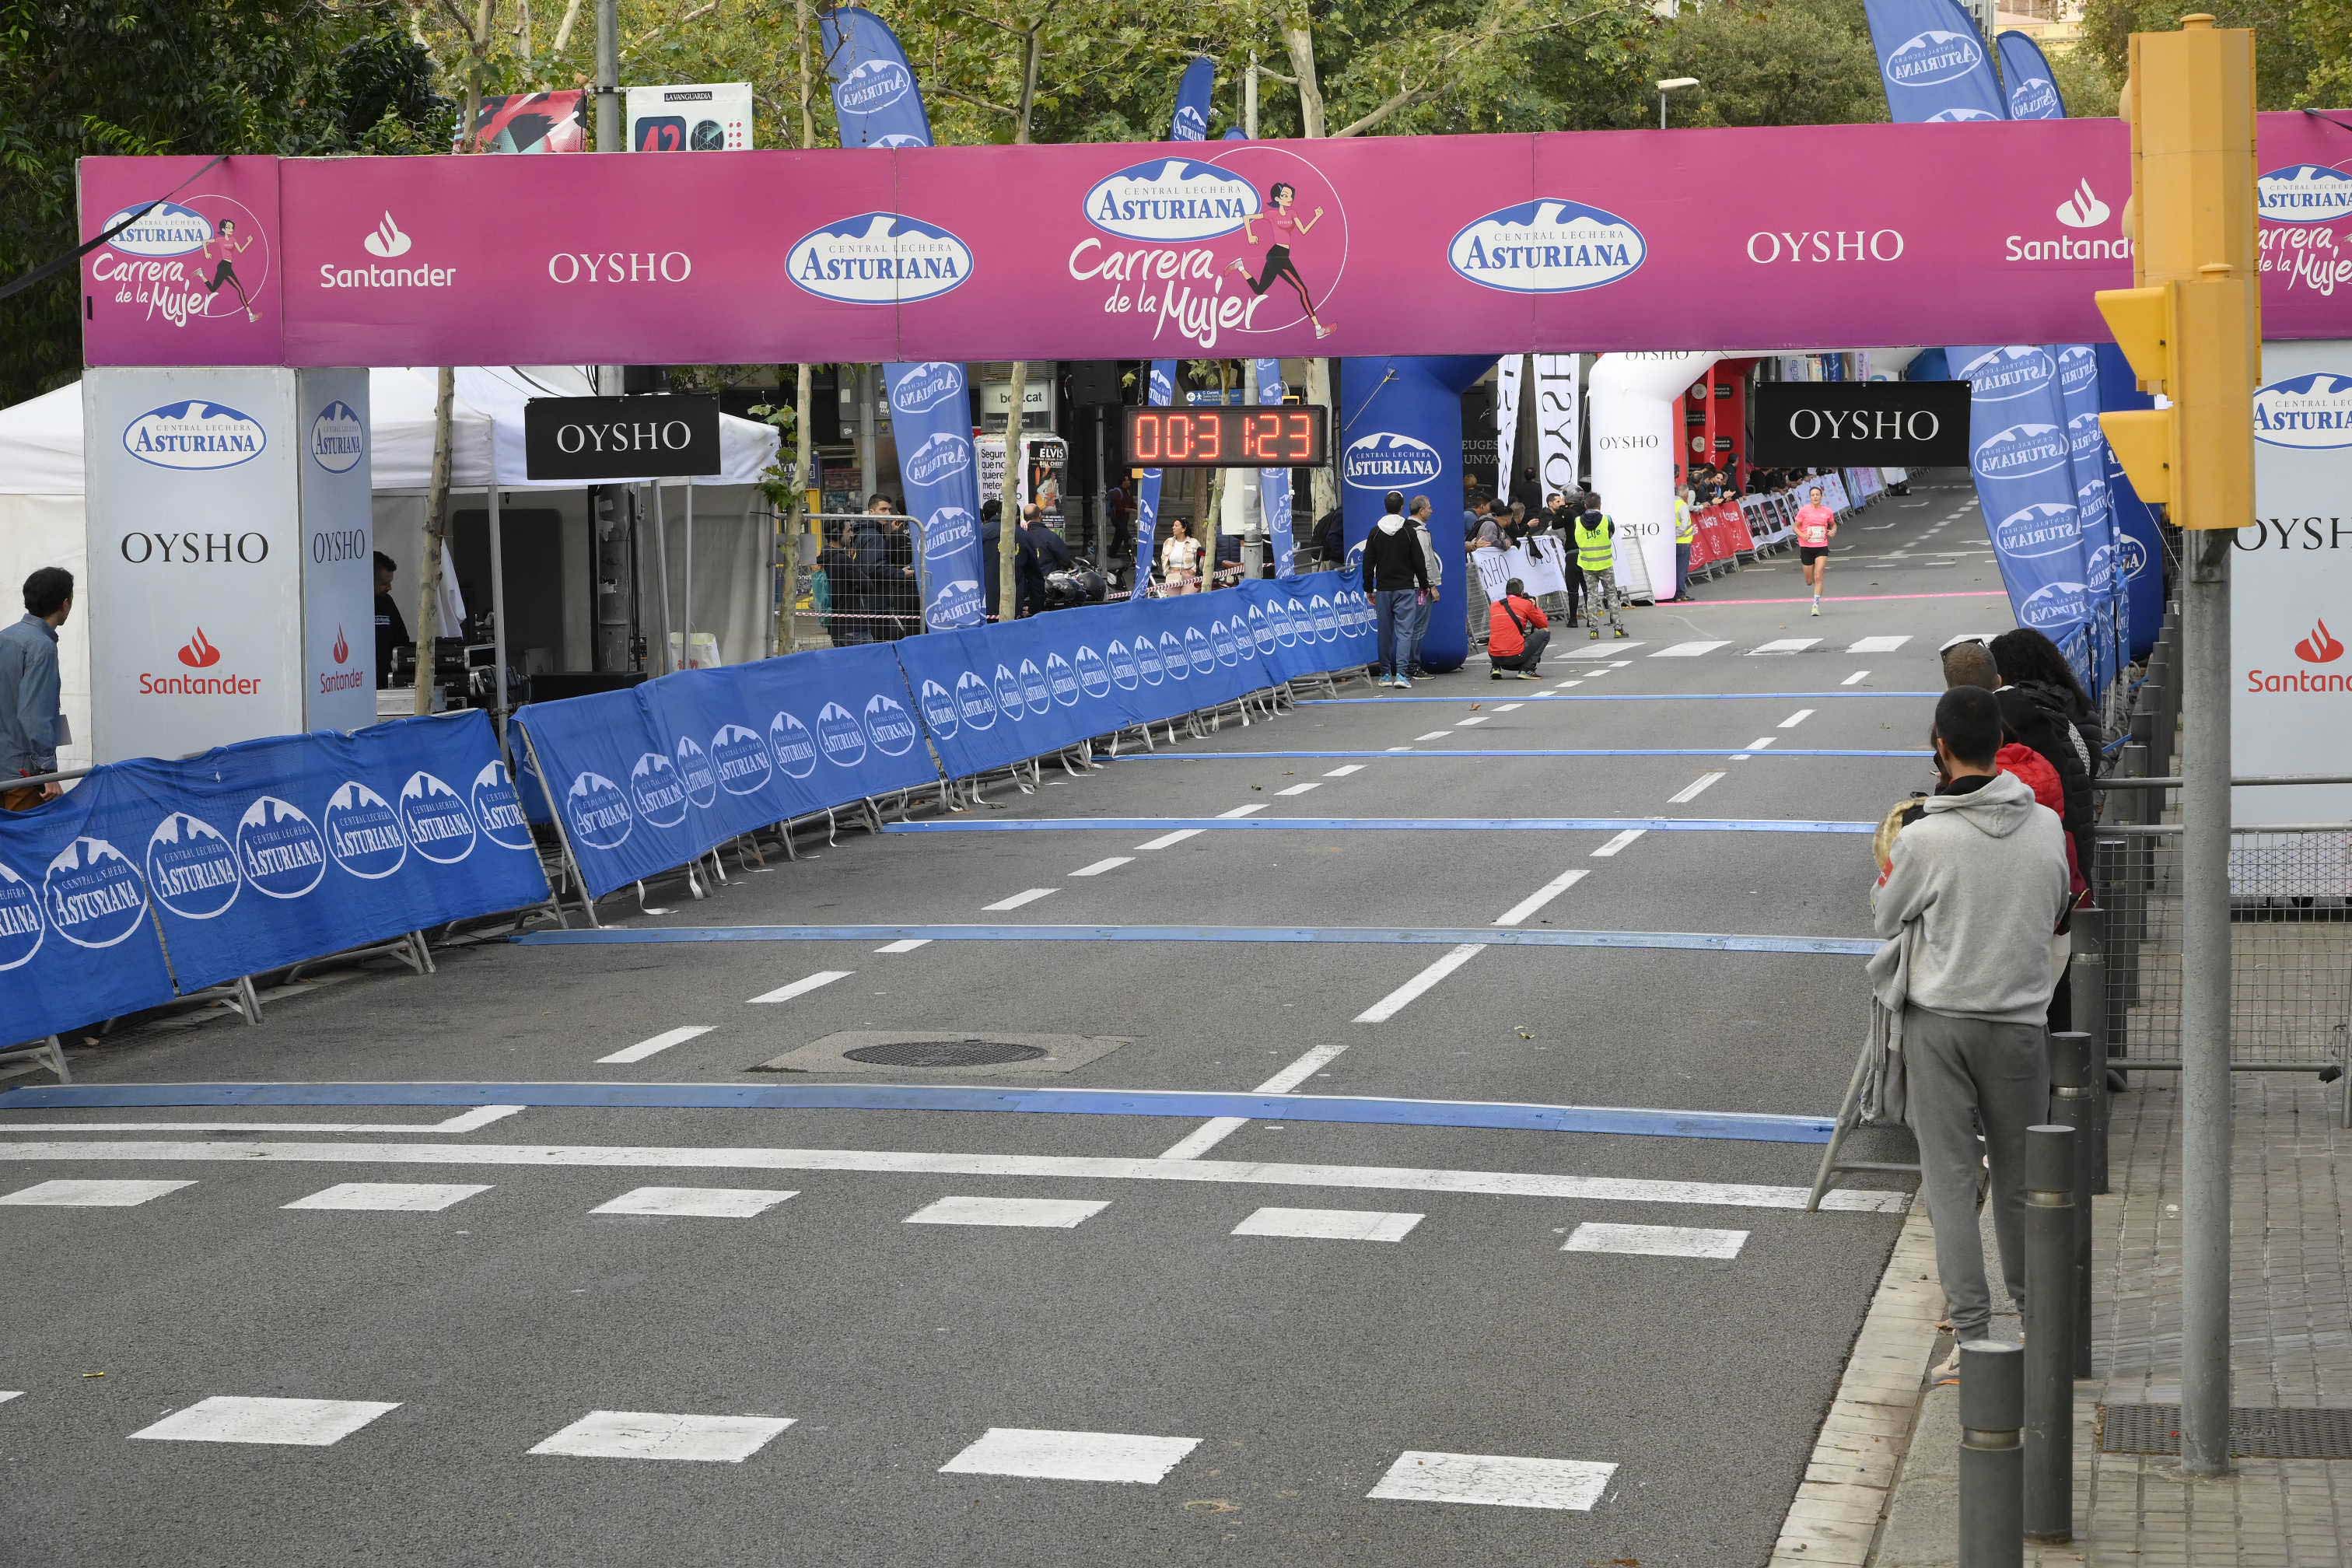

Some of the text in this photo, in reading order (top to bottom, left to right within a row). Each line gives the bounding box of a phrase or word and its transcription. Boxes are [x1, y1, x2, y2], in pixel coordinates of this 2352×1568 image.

[674, 92, 712, 100] VANGUARDIA
[1123, 185, 1242, 195] CENTRAL LECHERA
[1097, 189, 1246, 222] ASTURIANA
[111, 222, 204, 243] ASTURIANA
[1494, 230, 1625, 242] CENTRAL LECHERA
[2259, 227, 2333, 250] arrera
[828, 243, 952, 253] CENTRAL LECHERA
[1463, 235, 1631, 270] ASTURIANA
[1748, 229, 1905, 264] OYSHO
[2006, 236, 2134, 261] Santand
[93, 253, 184, 282] Carrera
[548, 252, 691, 284] OYSHO
[800, 247, 958, 281] ASTURIANA
[1069, 238, 1215, 281] Carrera
[2277, 250, 2291, 271] la
[320, 264, 457, 288] Santander
[116, 279, 219, 327] de la Mujer
[1104, 276, 1269, 348] de la Mujer
[1000, 392, 1042, 404] b.cat
[1790, 408, 1940, 441] OYSHO
[135, 426, 256, 453] ASTURIANA
[316, 434, 361, 455] ASTURIANA
[557, 420, 691, 454] OYSHO
[1600, 435, 1658, 450] OYSHO
[1040, 448, 1063, 458] ELVIS
[982, 461, 995, 471] que
[1346, 456, 1434, 477] ASTURIANA
[982, 480, 1002, 489] mete
[983, 492, 996, 500] este
[121, 532, 268, 563] OYSHO
[313, 529, 365, 564] OYSHO
[139, 673, 261, 695] Santander
[320, 669, 364, 694] Santander
[412, 803, 436, 814] CENTRAL
[340, 814, 365, 827] CENTRAL
[406, 809, 473, 844] ASTURIANA
[253, 824, 310, 845] CENTRAL LECHERA
[332, 821, 404, 857] ASTURIANA
[164, 844, 225, 863] CENTRAL LECHERA
[245, 838, 322, 878] ASTURIANA
[61, 873, 93, 890] CENTRAL
[156, 857, 237, 898] ASTURIANA
